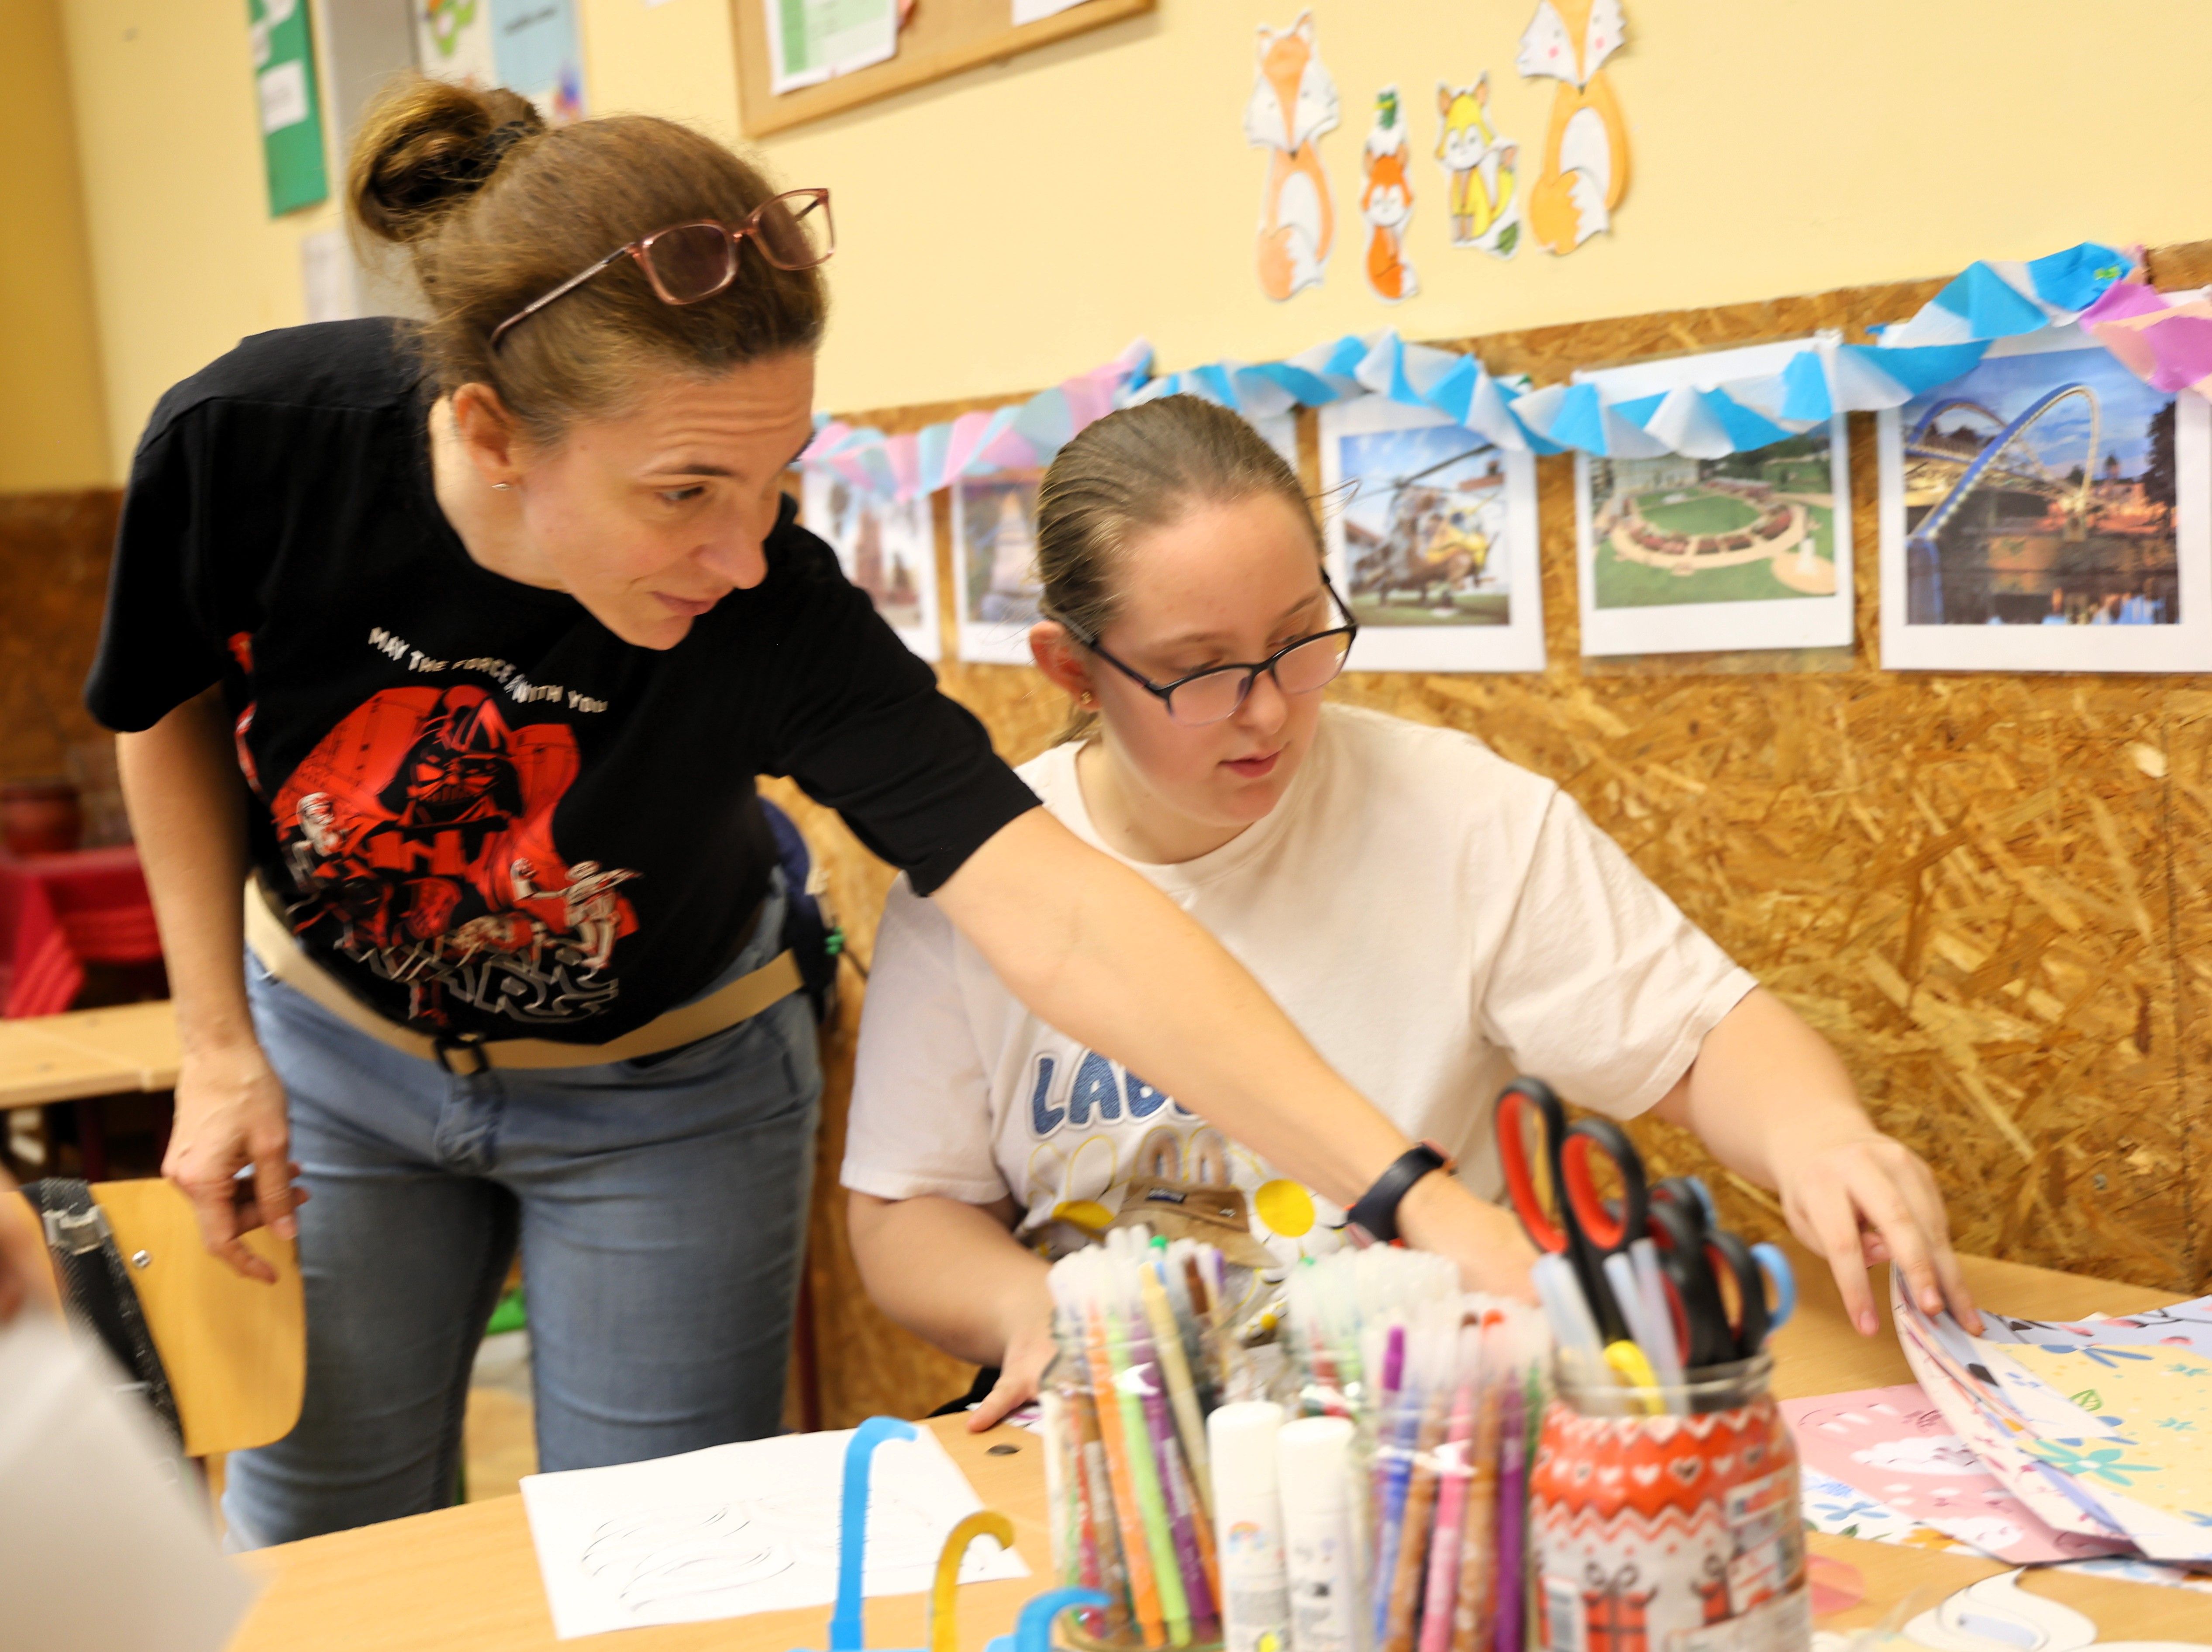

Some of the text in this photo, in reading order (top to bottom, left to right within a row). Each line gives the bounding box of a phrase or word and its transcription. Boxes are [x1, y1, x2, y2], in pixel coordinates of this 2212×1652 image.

[368, 626, 410, 661] MAY
[408, 650, 450, 673] THE
[568, 690, 608, 713] YOU
[1032, 1051, 1193, 1135] LAB
